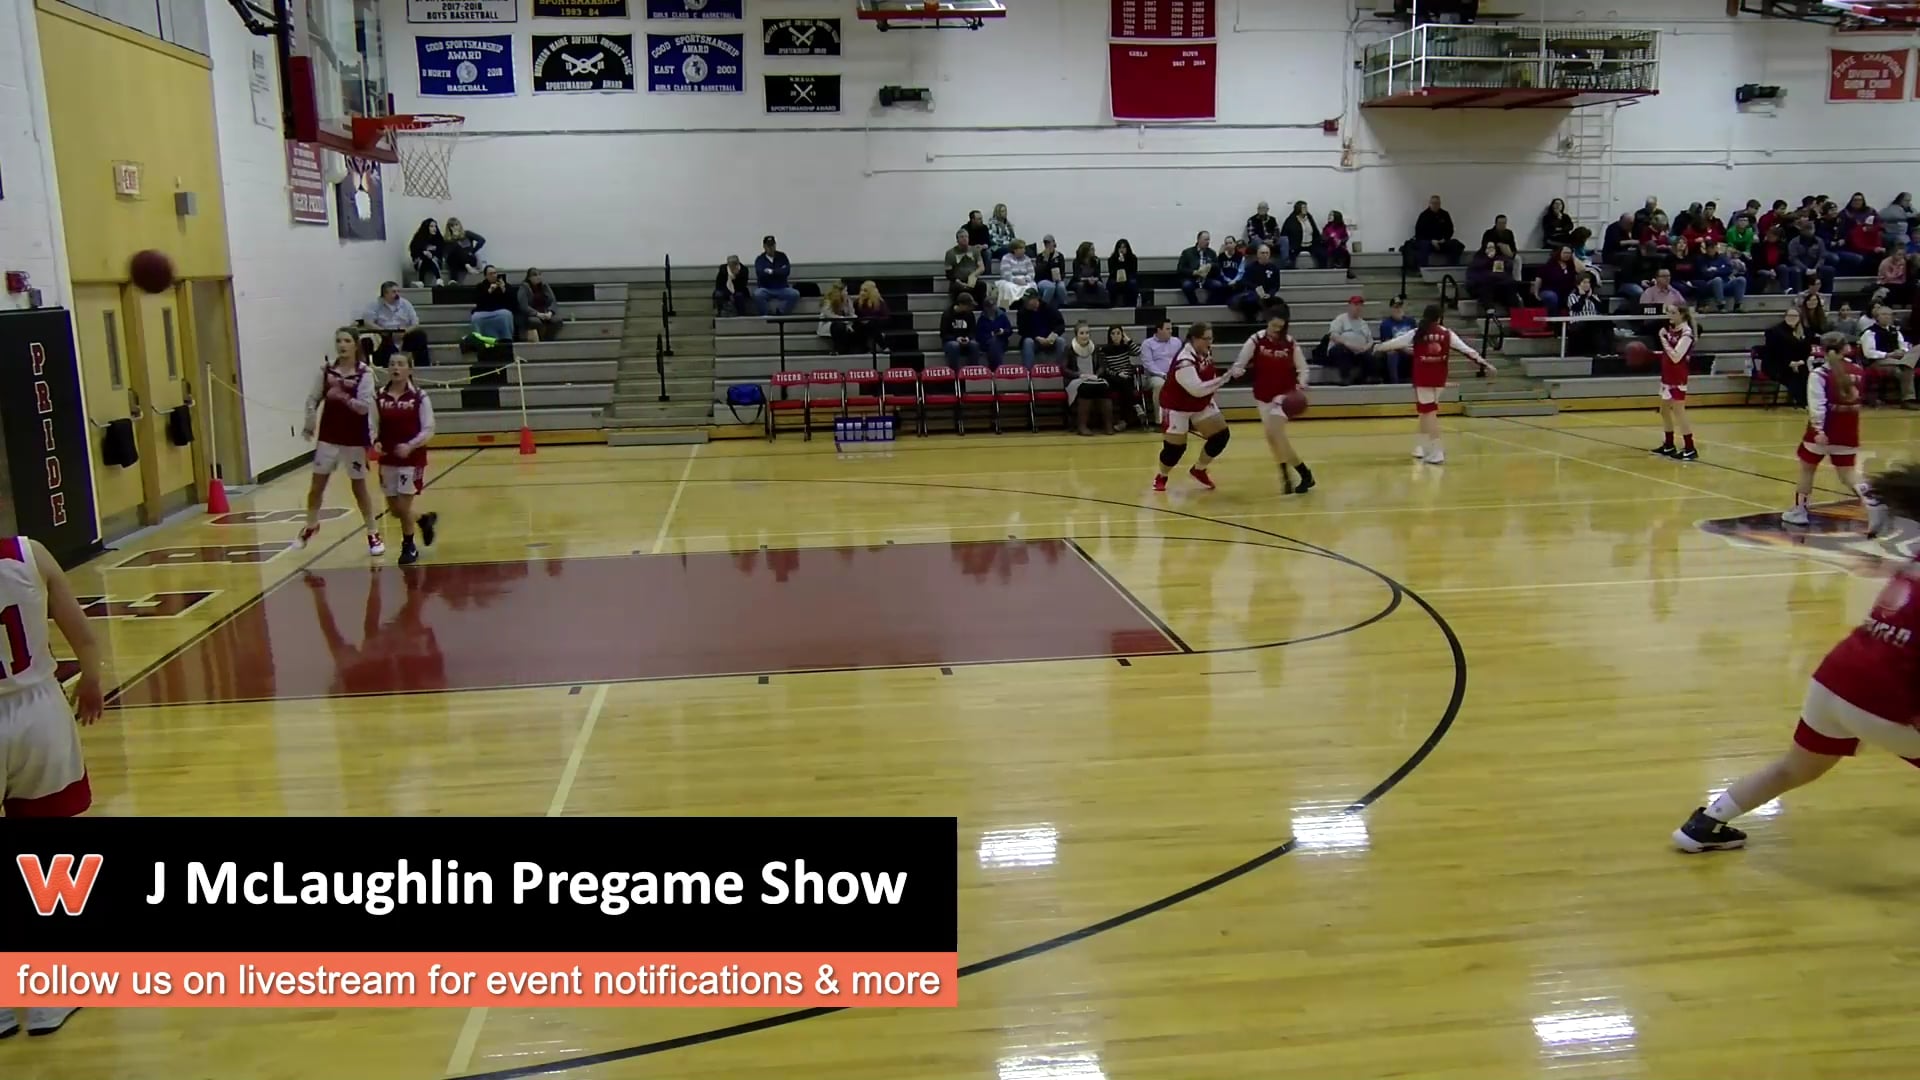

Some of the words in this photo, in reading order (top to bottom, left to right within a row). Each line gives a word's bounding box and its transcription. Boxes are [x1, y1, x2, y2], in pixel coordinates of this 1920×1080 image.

[427, 11, 447, 19] BOYS
[450, 11, 499, 19] BASKETBALL
[651, 41, 672, 59] GOOD
[674, 34, 740, 57] SPORTSMANSHIP
[682, 45, 709, 53] AWARD
[447, 51, 482, 60] AWARD
[654, 65, 676, 74] EAST
[887, 370, 912, 378] TIGERS
[926, 367, 951, 377] TIGERS
[963, 367, 987, 376] TIGERS
[1000, 366, 1024, 375] TIGERS
[1035, 365, 1060, 374] TIGERS
[777, 373, 801, 382] TIGERS
[813, 371, 838, 380] TIGERS
[849, 371, 875, 379] TIGERS
[30, 342, 67, 527] PRIDE
